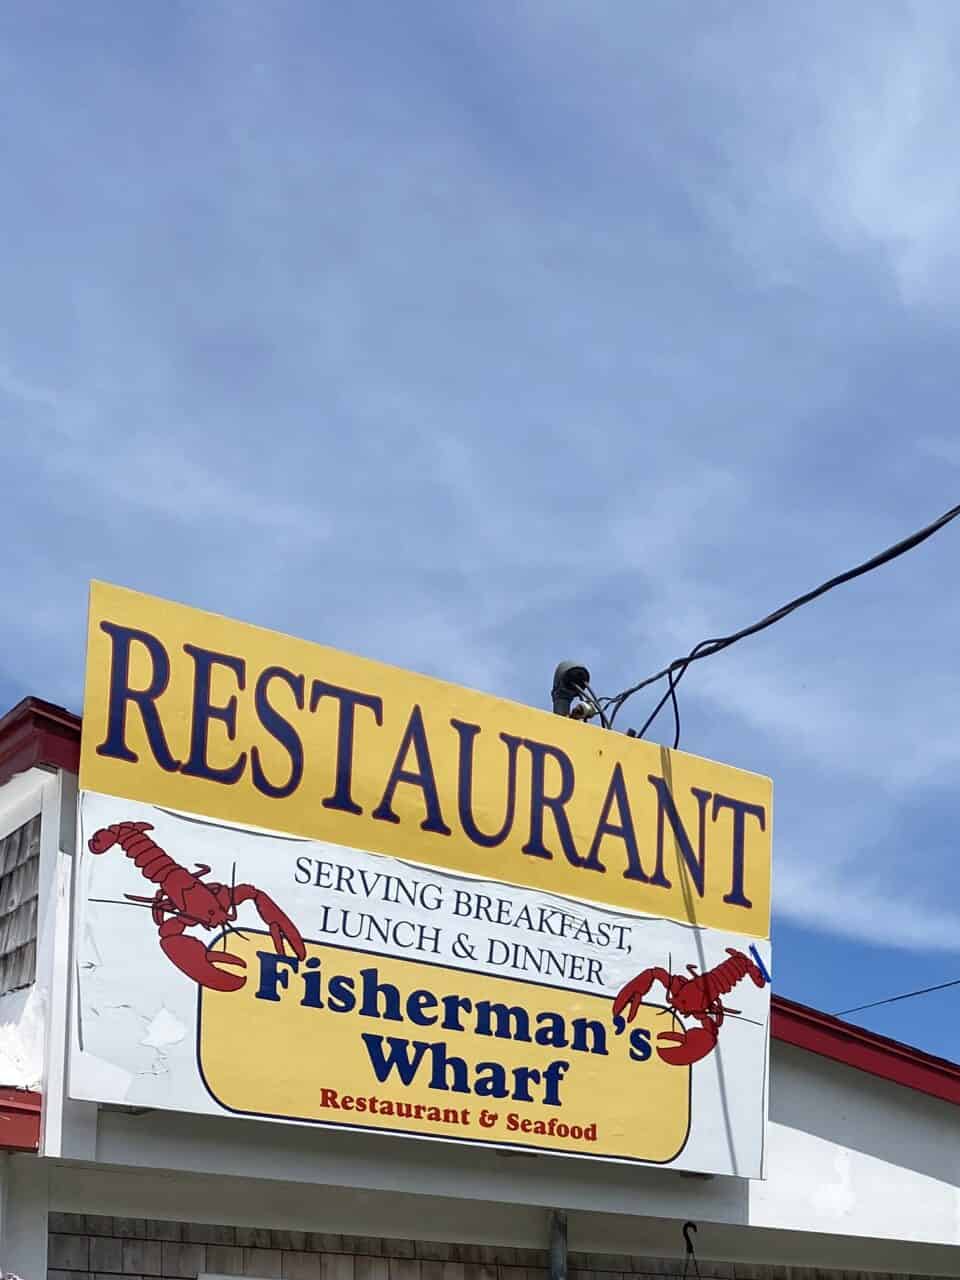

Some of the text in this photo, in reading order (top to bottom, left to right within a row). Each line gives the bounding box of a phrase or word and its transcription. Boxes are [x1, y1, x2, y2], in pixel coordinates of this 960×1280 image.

[96, 620, 766, 908] RESTAURANT
[294, 856, 633, 954] SERVING BREAKFAST,
[319, 905, 605, 986] LUNCH & DINNER
[255, 950, 653, 1063] Fisherman's
[361, 1032, 570, 1107] Wharf
[319, 1087, 598, 1142] Restaurant & Seafood
